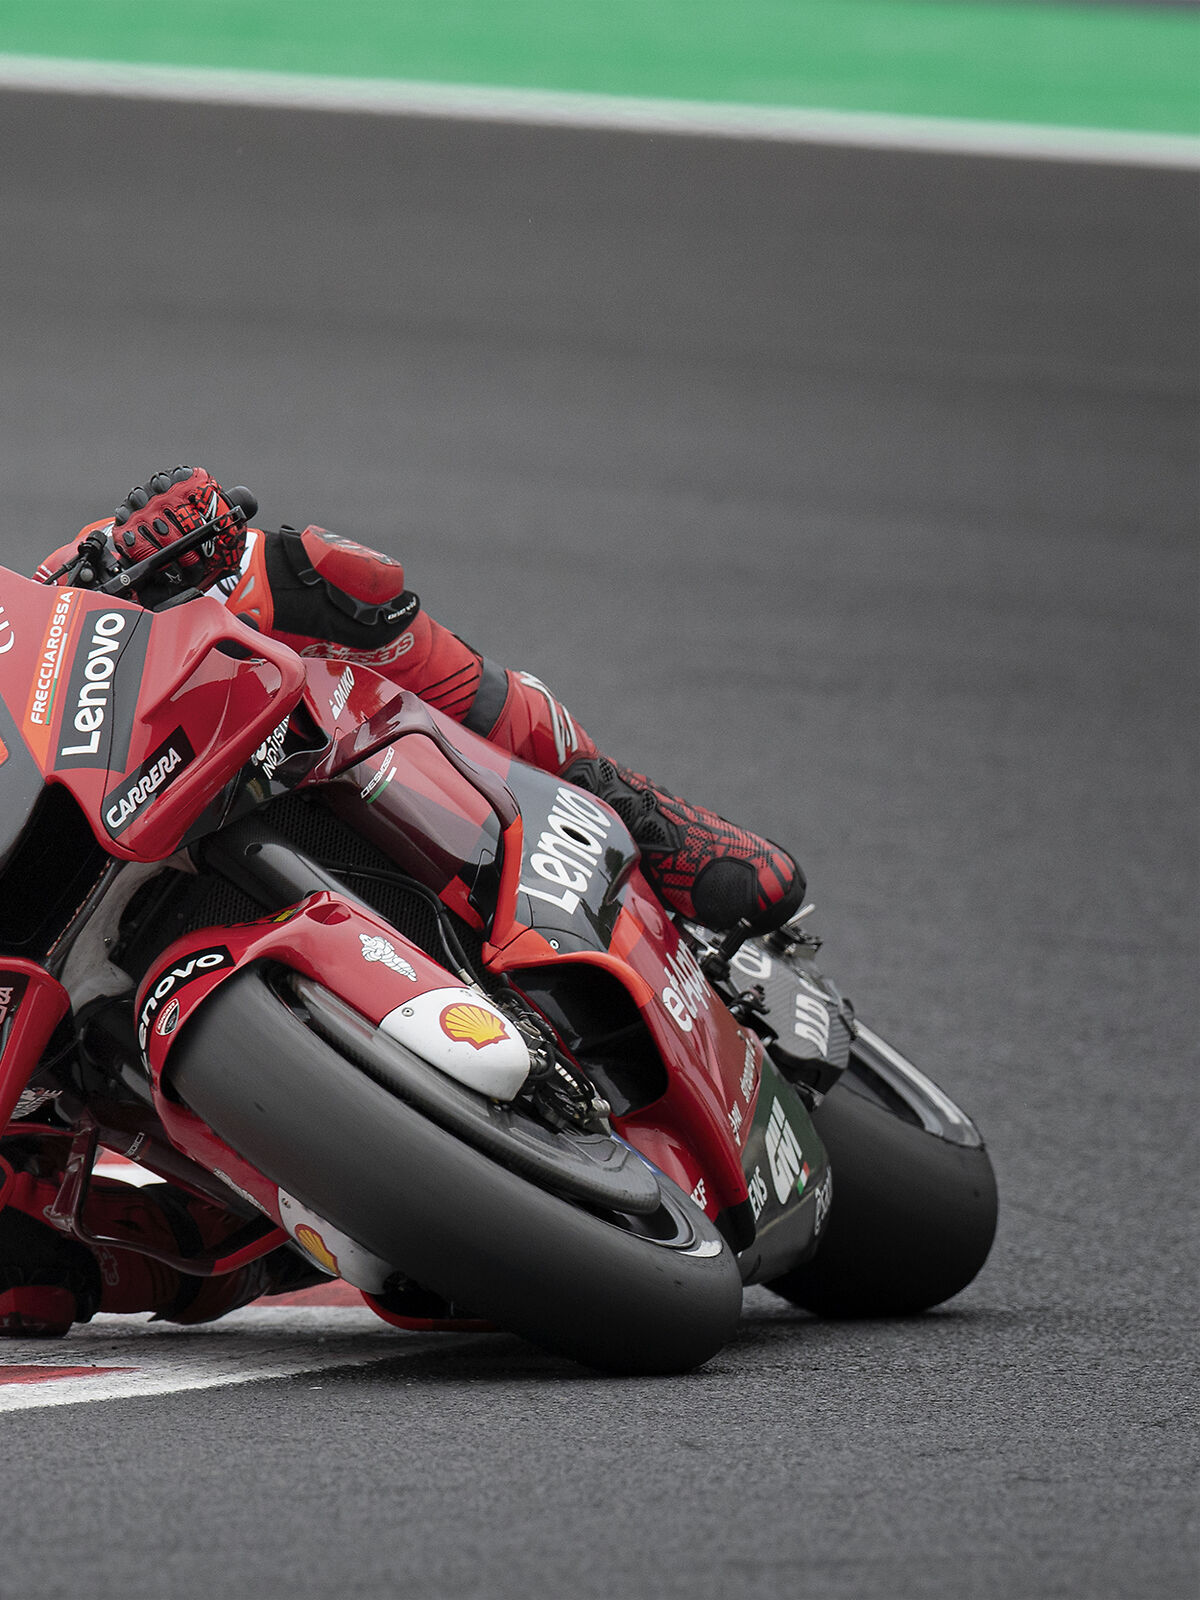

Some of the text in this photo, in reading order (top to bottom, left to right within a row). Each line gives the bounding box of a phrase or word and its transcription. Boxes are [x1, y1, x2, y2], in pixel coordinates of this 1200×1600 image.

[30, 591, 74, 724] FRECCIAROSSA
[61, 612, 126, 756] Lenovo
[106, 746, 182, 828] CARRERA
[517, 786, 612, 916] Lenovo
